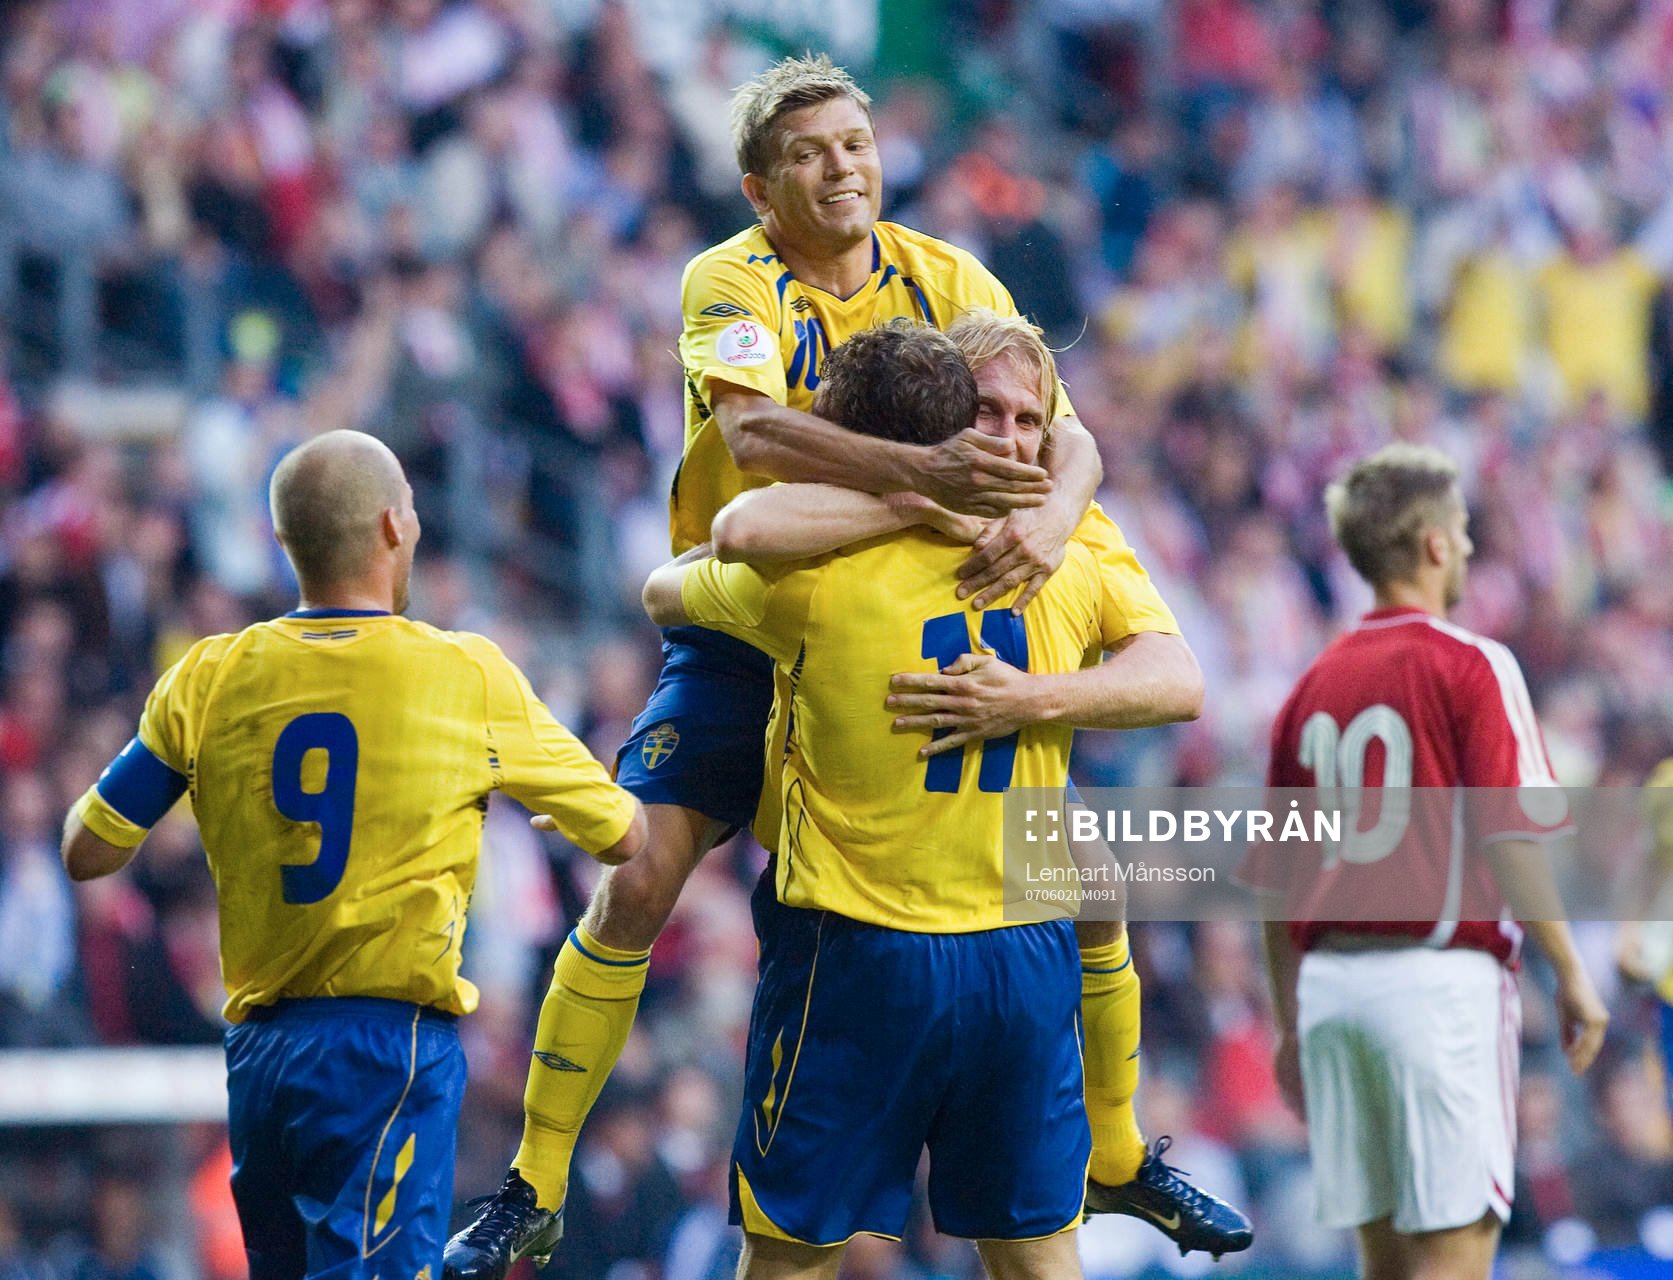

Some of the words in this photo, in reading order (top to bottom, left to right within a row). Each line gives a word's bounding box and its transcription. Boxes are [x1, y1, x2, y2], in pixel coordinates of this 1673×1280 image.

[921, 608, 1029, 794] 11
[1298, 704, 1413, 870] 10
[272, 712, 359, 905] 9
